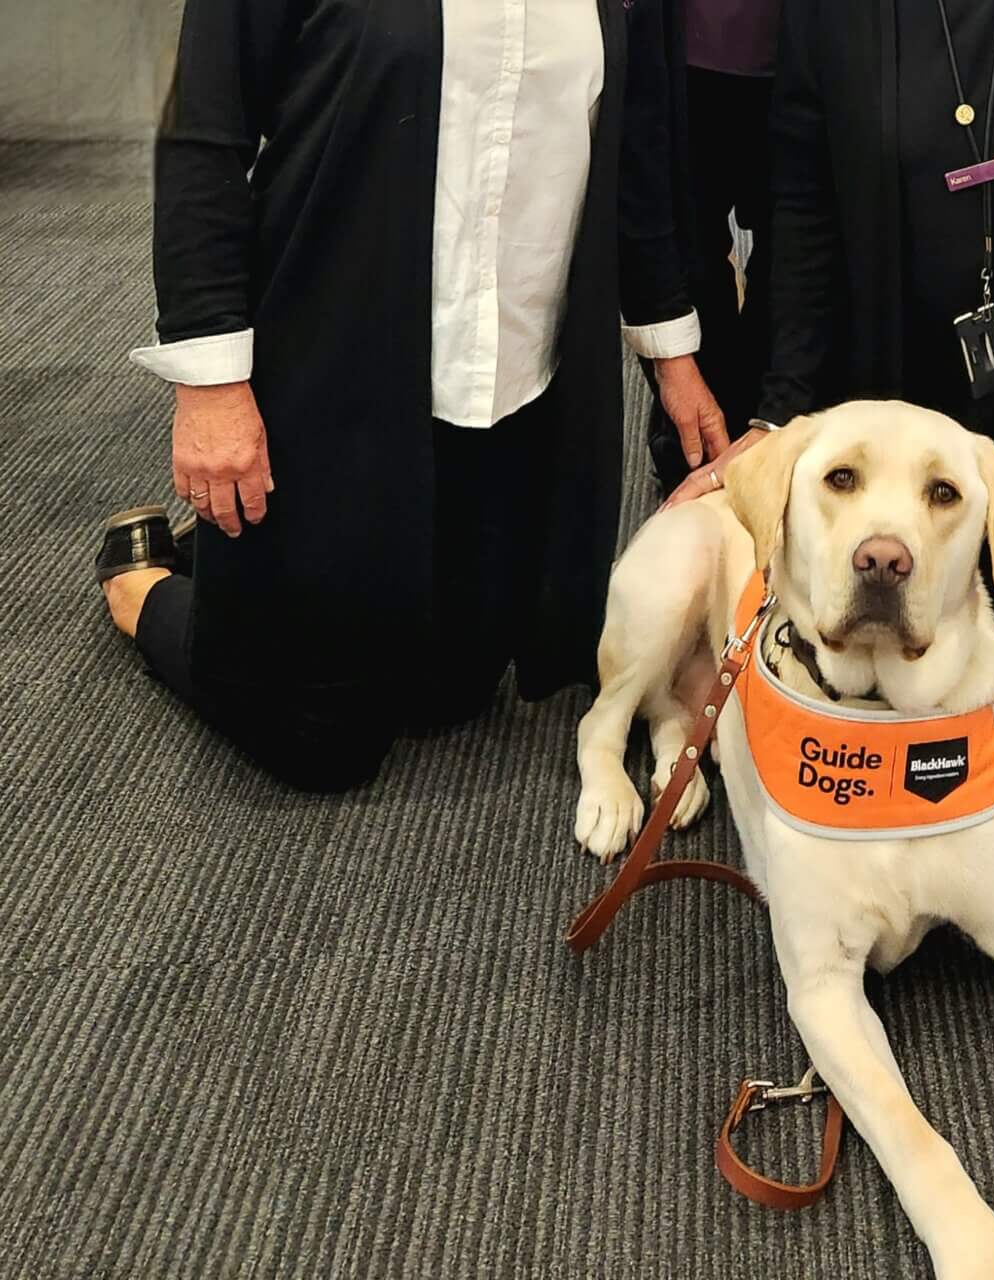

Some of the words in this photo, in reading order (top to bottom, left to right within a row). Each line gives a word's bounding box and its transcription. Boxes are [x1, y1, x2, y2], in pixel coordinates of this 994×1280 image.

[950, 174, 972, 186] Karen
[800, 736, 882, 770] Guide
[910, 754, 966, 772] BlackHawk
[798, 761, 874, 805] Dogs.
